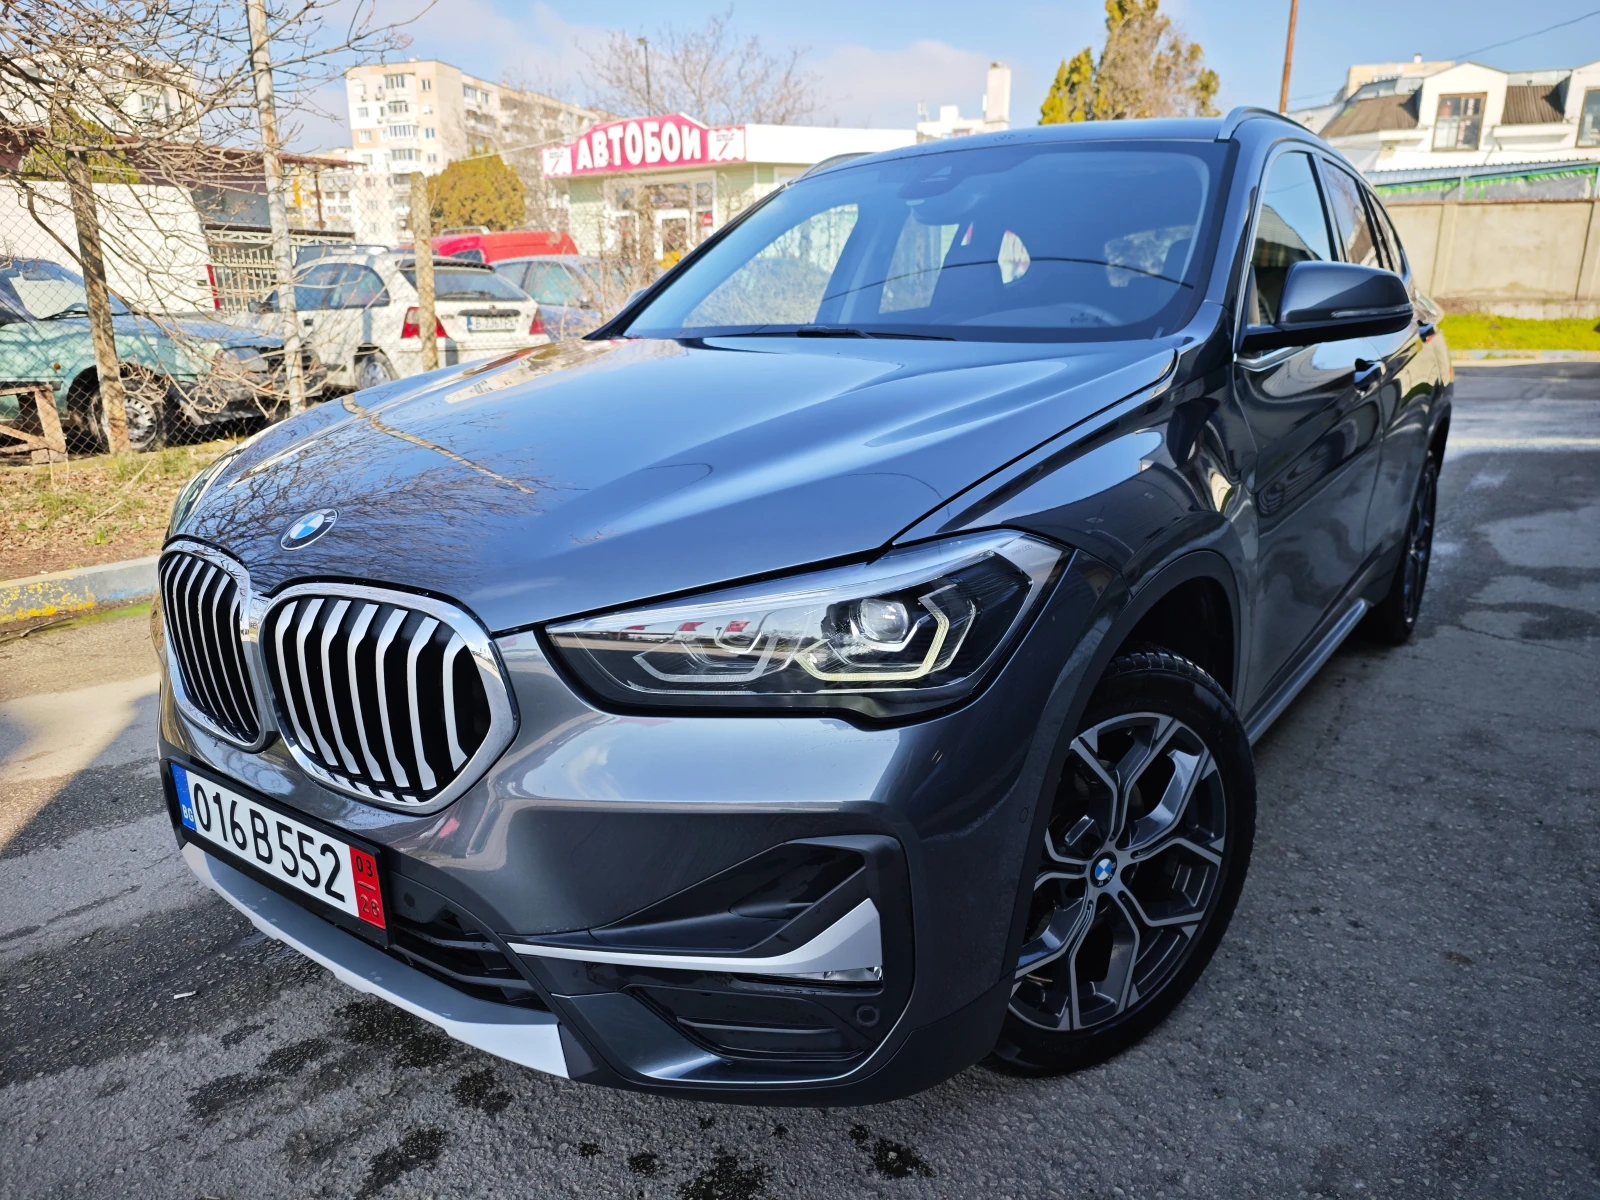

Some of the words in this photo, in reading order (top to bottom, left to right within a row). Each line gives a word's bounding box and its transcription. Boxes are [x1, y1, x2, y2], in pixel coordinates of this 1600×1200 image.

[576, 121, 701, 170] АВТОБОИ
[182, 804, 194, 822] BG
[194, 783, 346, 904] 016B552
[356, 855, 374, 877] 03
[360, 893, 380, 918] 28
